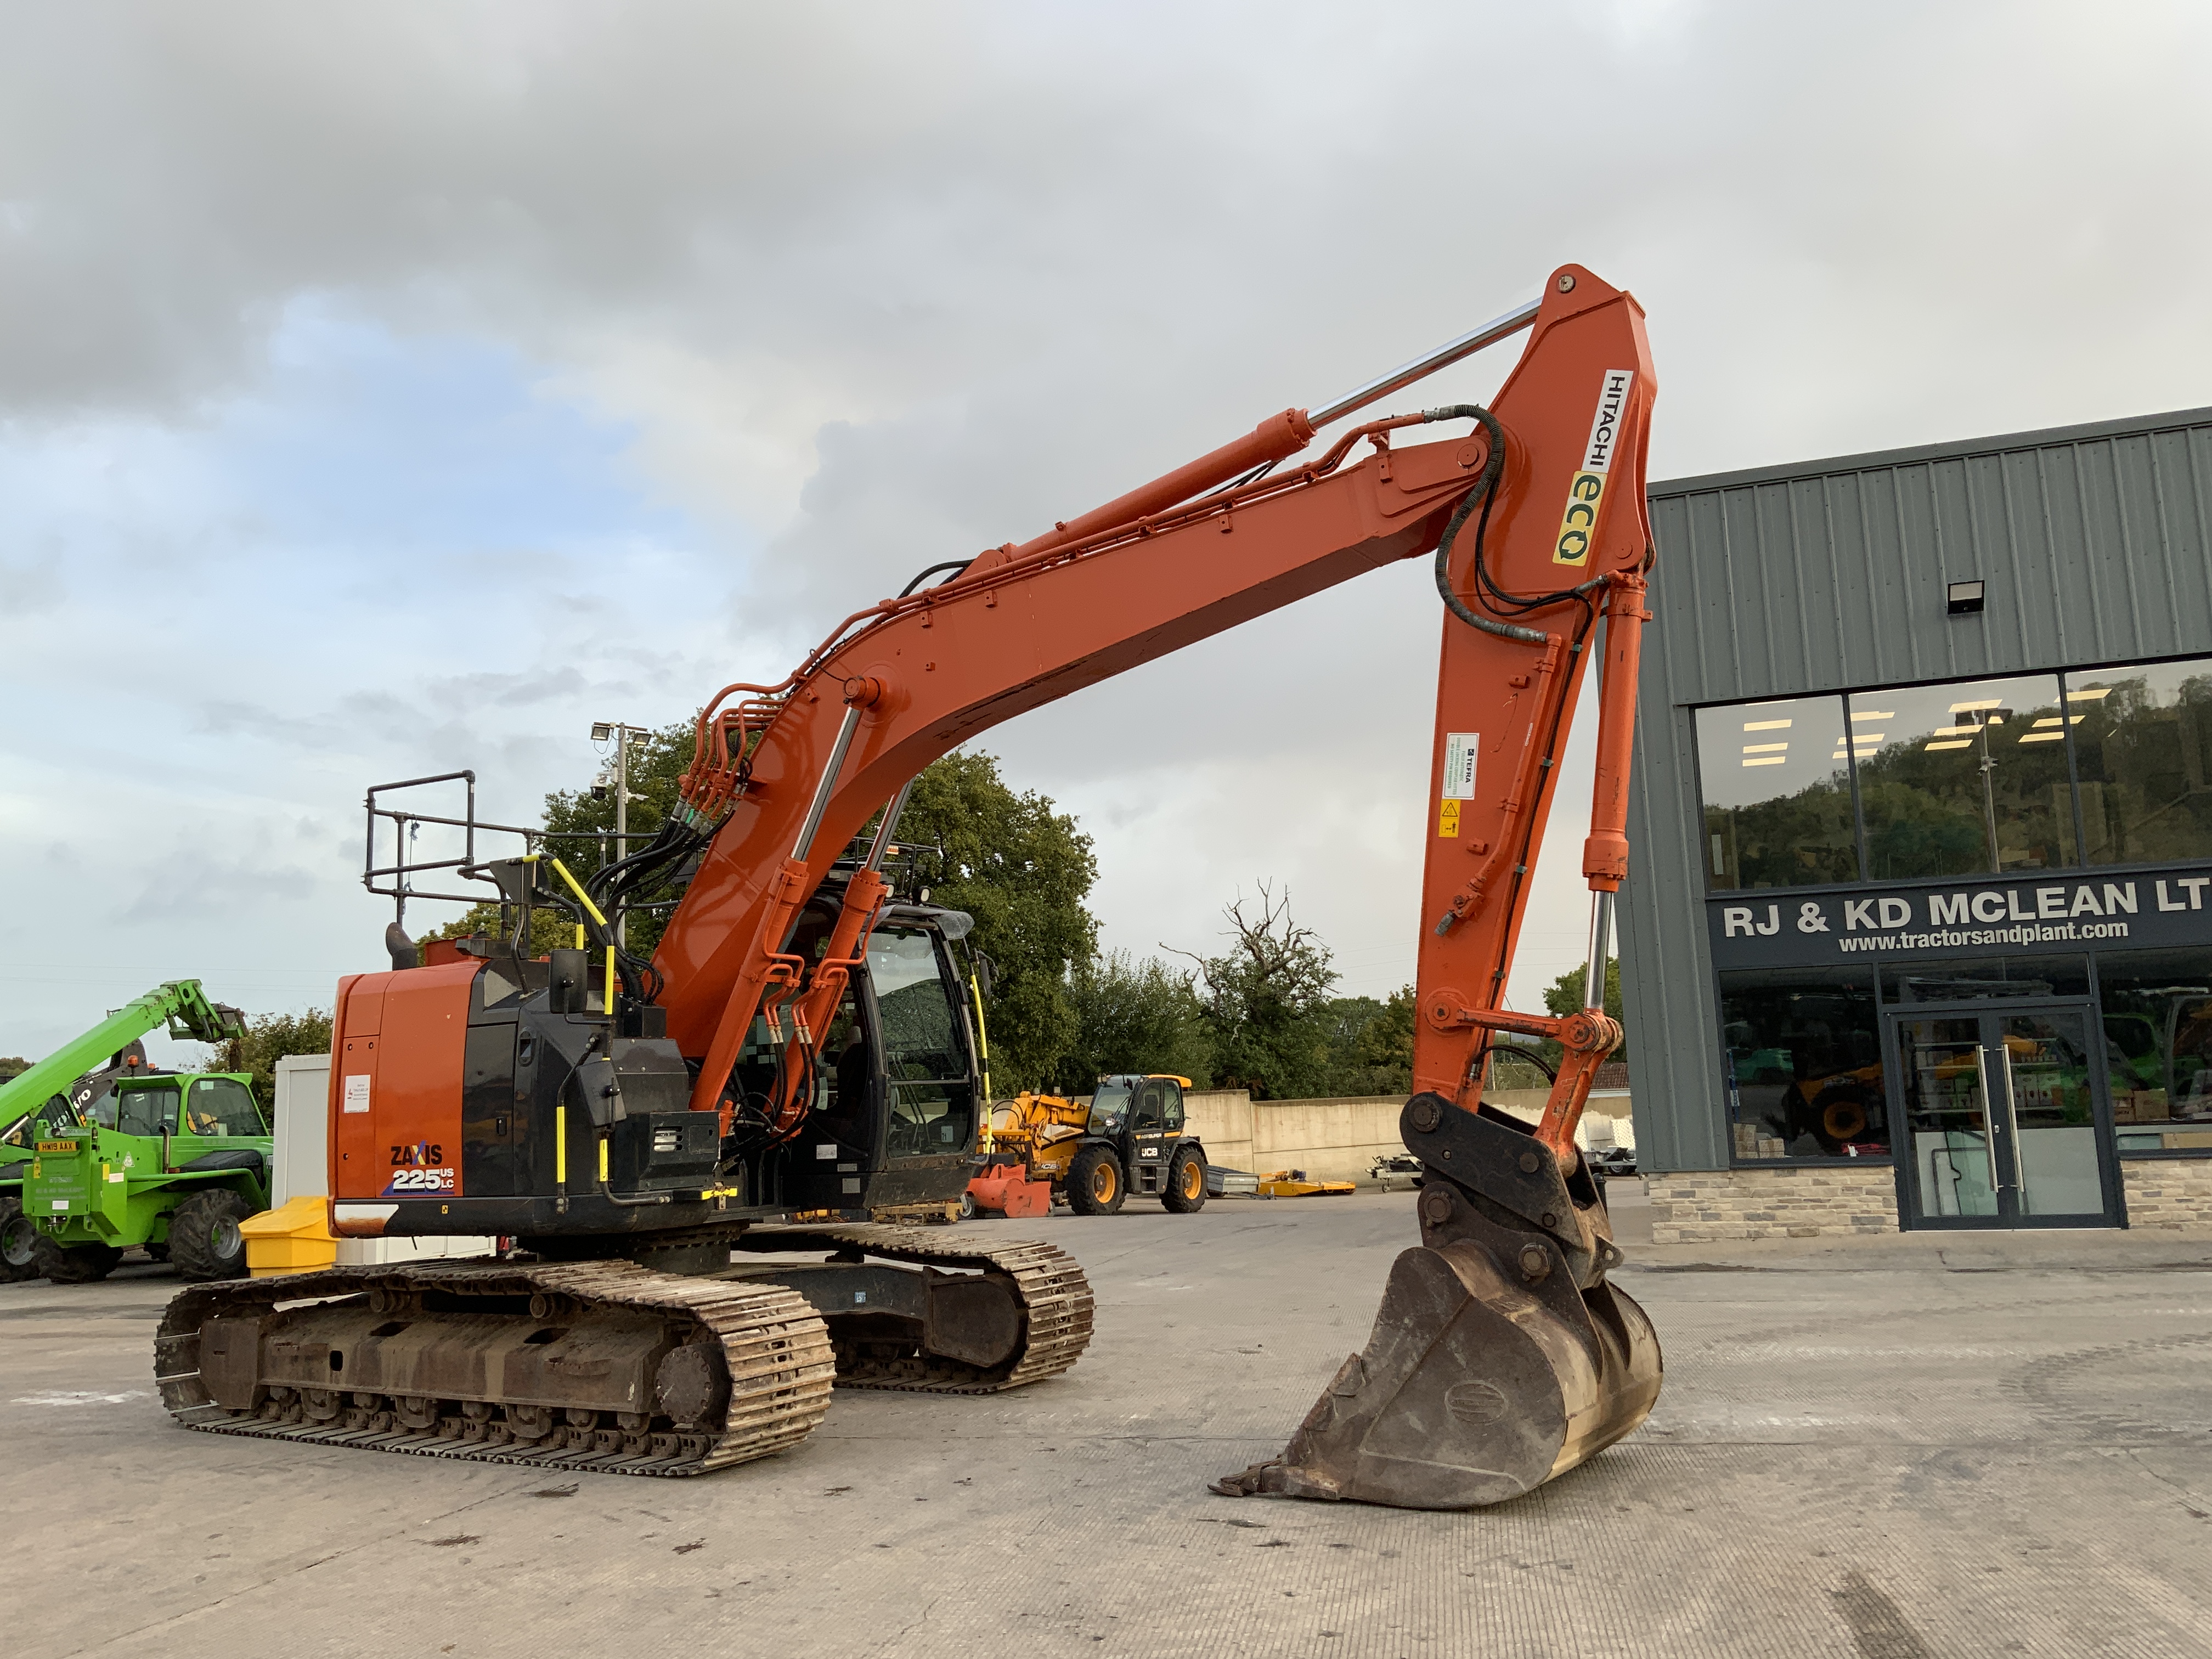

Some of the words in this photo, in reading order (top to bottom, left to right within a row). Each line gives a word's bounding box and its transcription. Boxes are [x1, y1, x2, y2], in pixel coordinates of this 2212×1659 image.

[1589, 376, 1625, 466] HITACHI
[1723, 905, 1780, 938] RJ
[1797, 901, 1831, 933] &
[1843, 897, 1912, 930] KD
[1928, 882, 2138, 926] MCLEAN
[1838, 922, 2129, 952] www.tractorsandplant.com
[391, 1139, 442, 1165] ZAXIS
[1141, 1147, 1158, 1157] JCB
[393, 1169, 441, 1190] 225
[440, 1168, 454, 1178] US
[441, 1179, 454, 1188] LC
